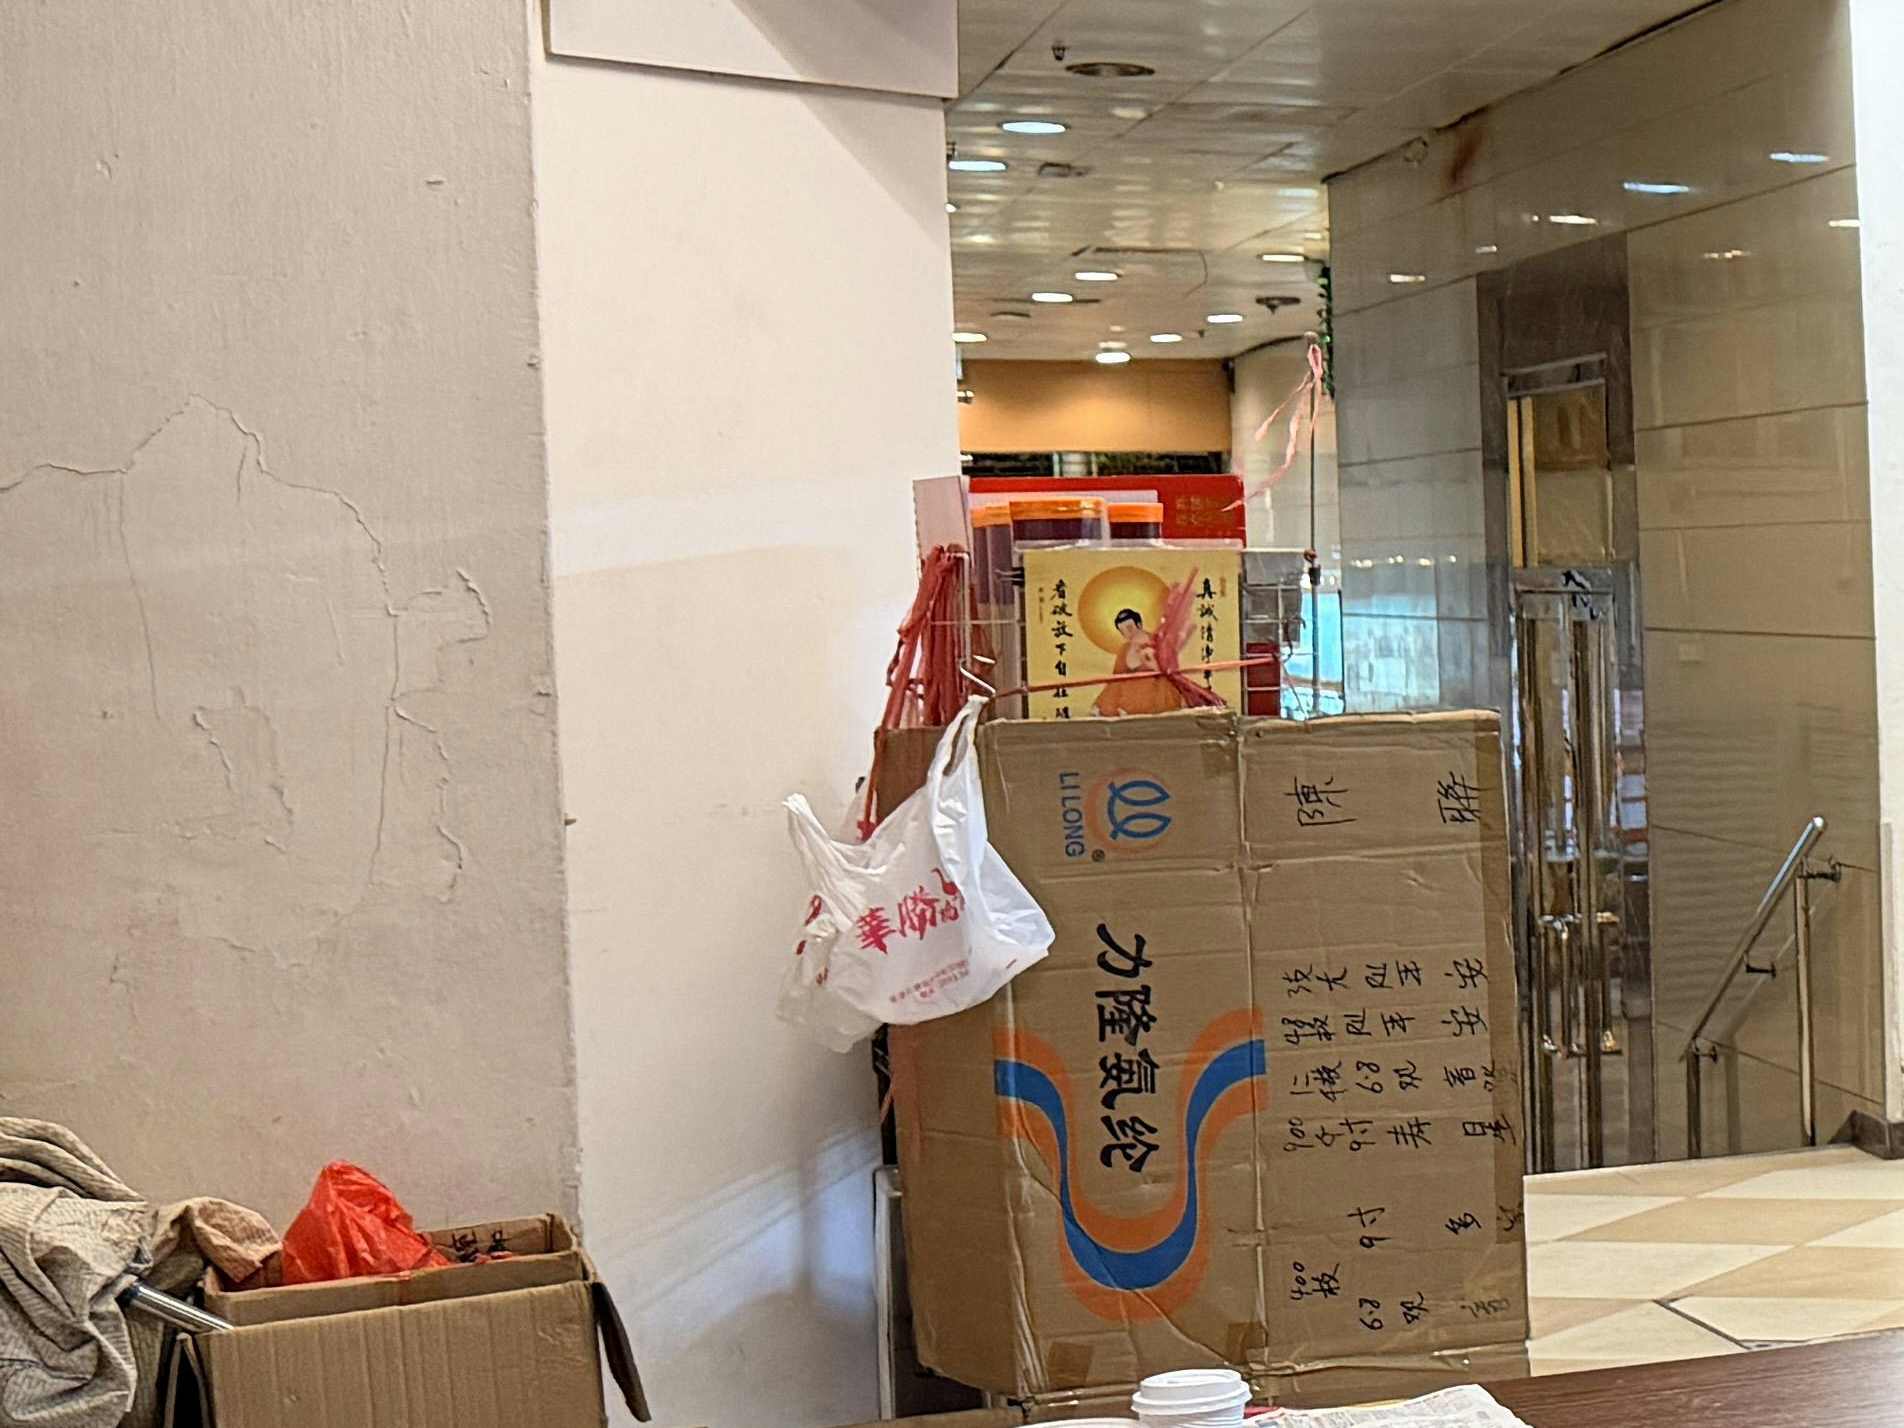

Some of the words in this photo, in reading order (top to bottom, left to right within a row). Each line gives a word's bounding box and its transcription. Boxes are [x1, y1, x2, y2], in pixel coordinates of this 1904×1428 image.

[1059, 772, 1080, 794] LI
[1062, 796, 1086, 857] LONG
[1094, 922, 1160, 1174] 力隆氨纶
